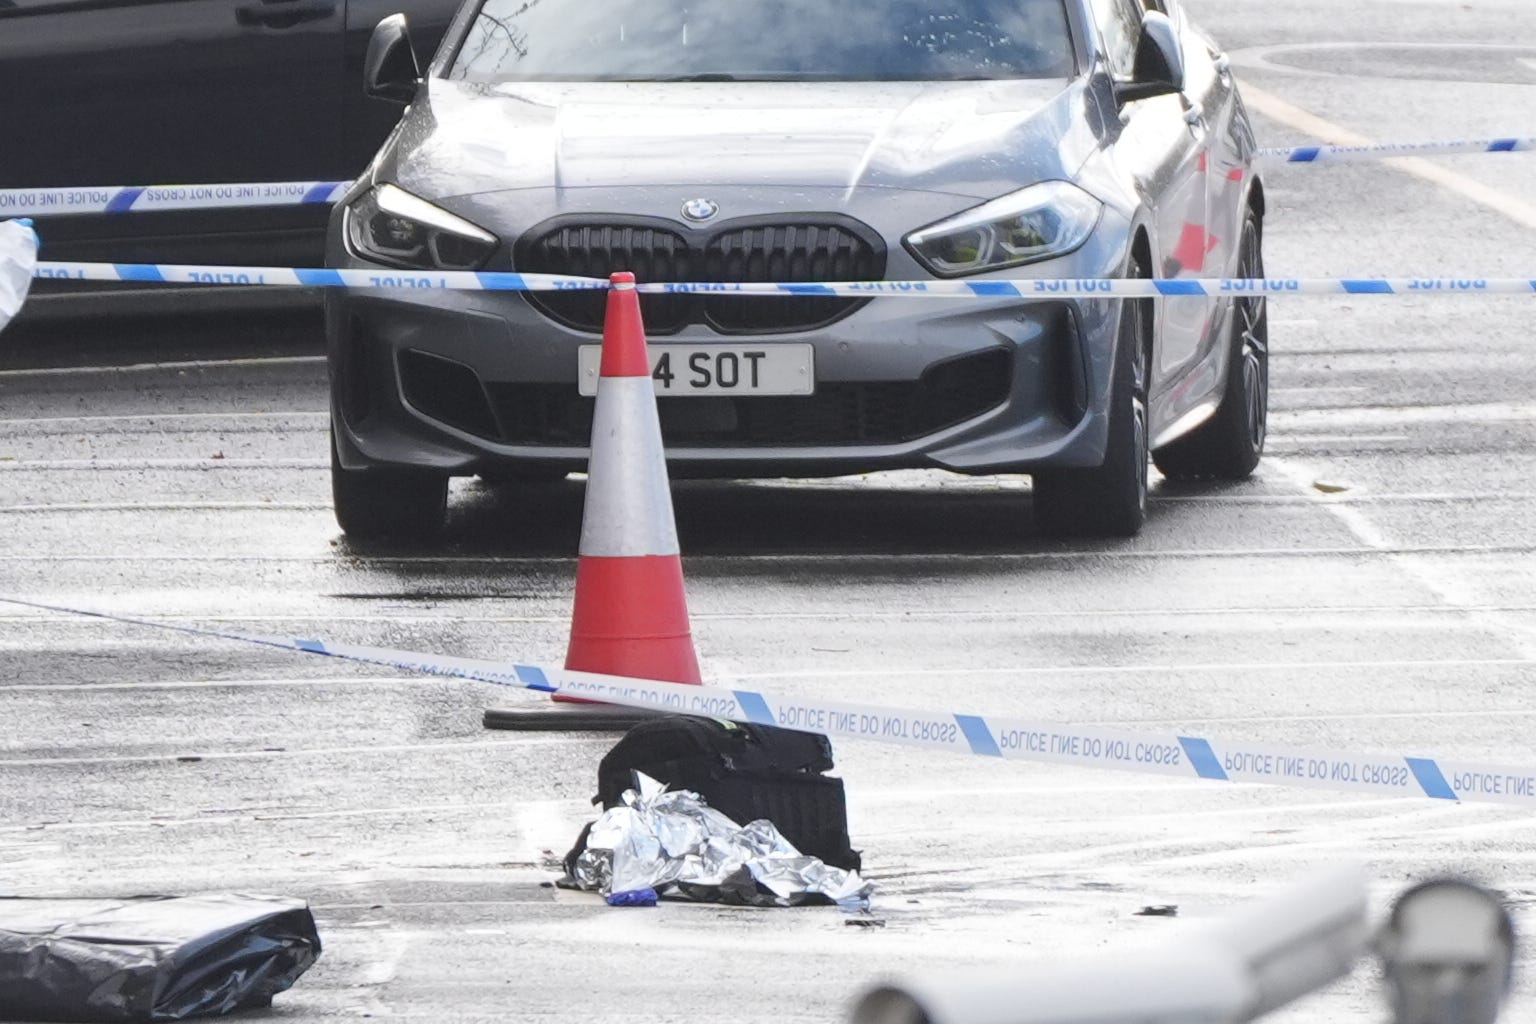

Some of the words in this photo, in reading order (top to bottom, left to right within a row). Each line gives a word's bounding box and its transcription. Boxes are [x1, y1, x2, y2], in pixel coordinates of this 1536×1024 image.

[147, 189, 186, 201] CROSS
[190, 188, 213, 200] NOT
[216, 188, 232, 199] DO
[236, 186, 263, 198] LINE
[264, 184, 305, 197] POLICE
[19, 194, 35, 207] DO
[40, 193, 64, 206] LINE
[67, 191, 108, 205] POLICE
[689, 351, 766, 389] SOT
